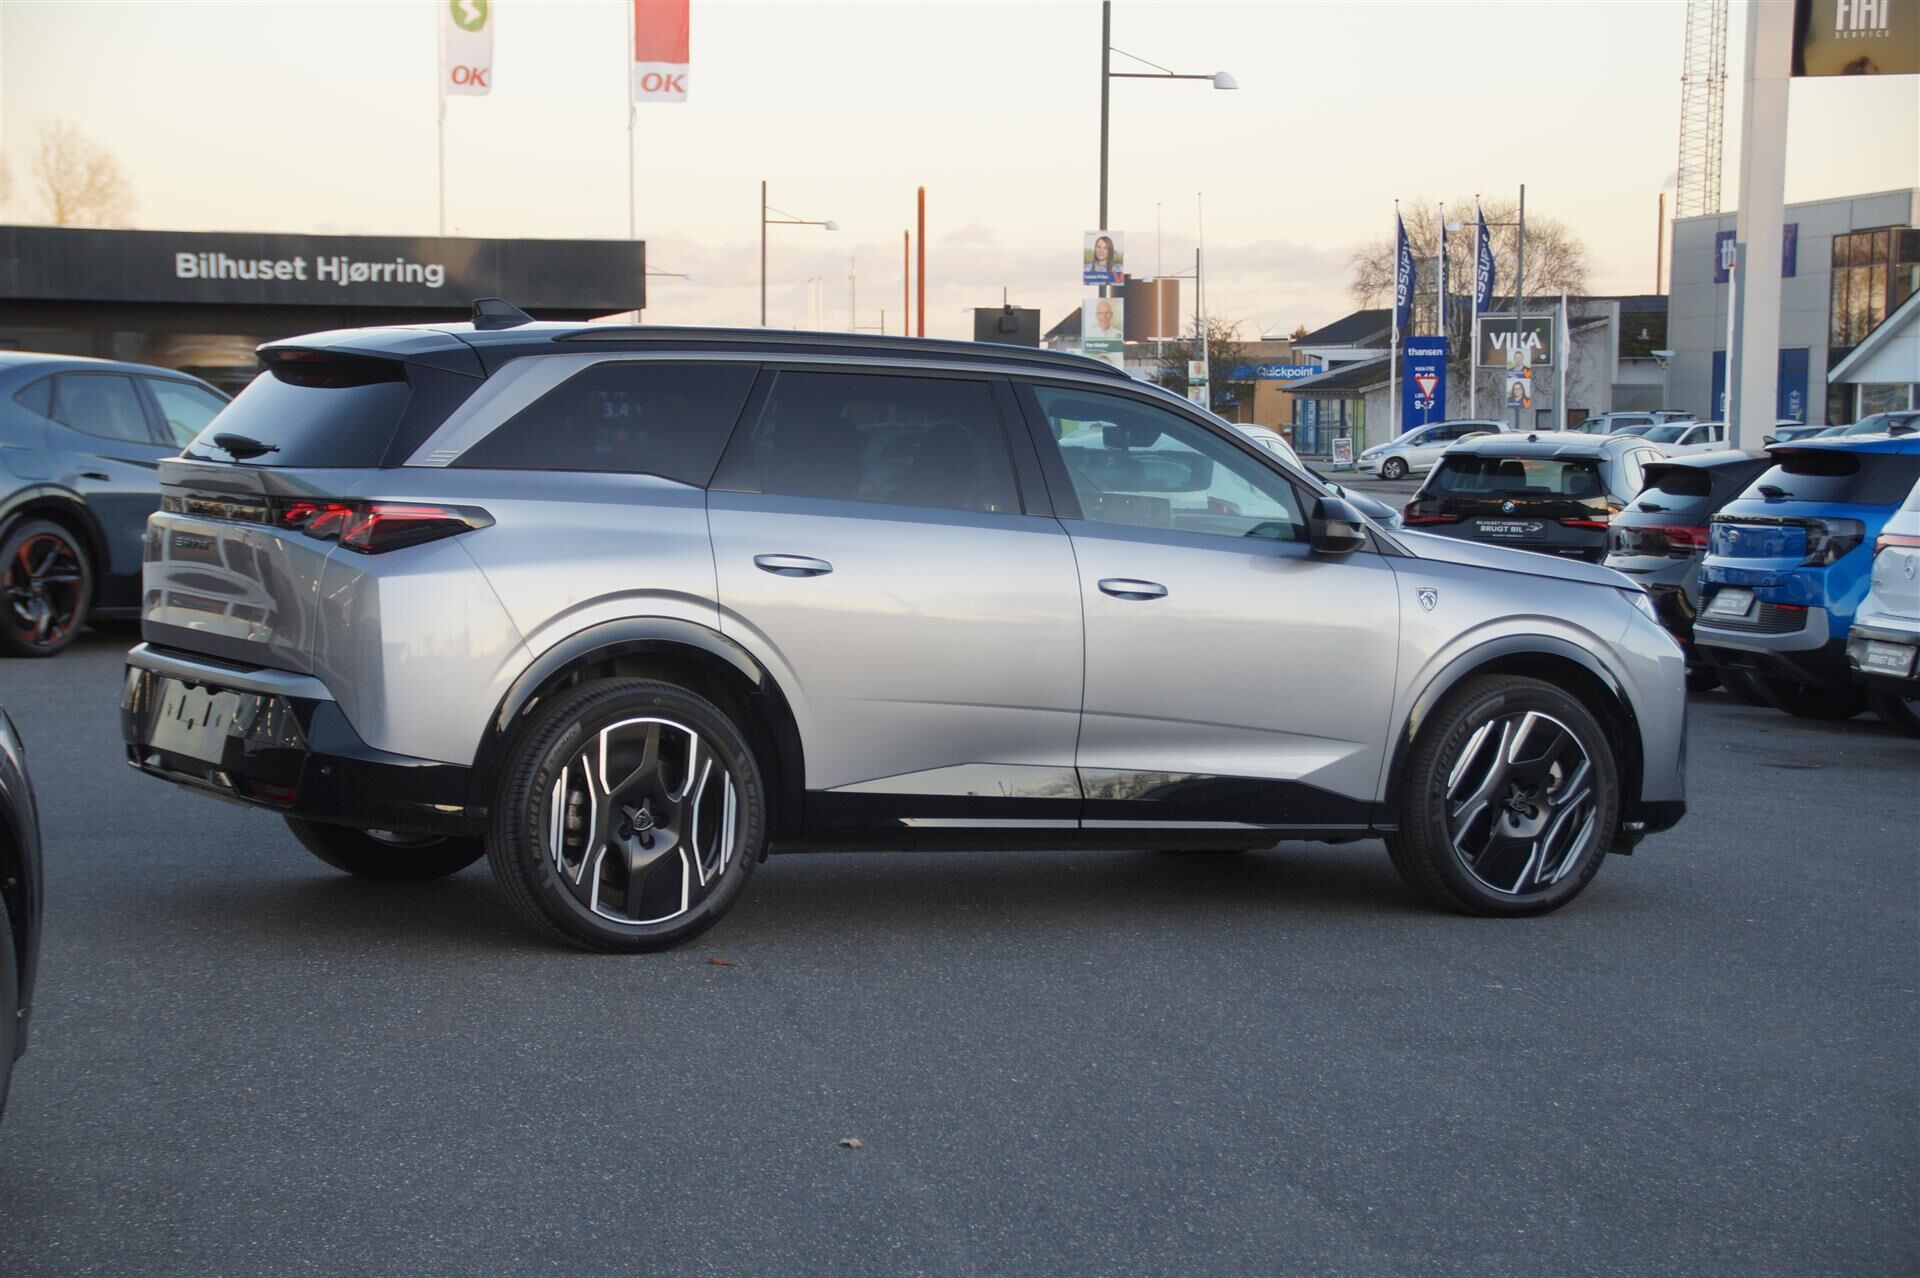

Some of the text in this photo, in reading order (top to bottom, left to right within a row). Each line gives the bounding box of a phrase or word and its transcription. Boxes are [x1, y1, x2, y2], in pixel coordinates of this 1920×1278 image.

[1835, 30, 1889, 39] SERVICE
[451, 65, 488, 87] OK
[641, 72, 687, 93] OK
[175, 252, 445, 288] Bilhuset Hjørring
[1489, 331, 1542, 350] VIKA
[1407, 347, 1443, 356] thansen
[1257, 366, 1313, 378] Quickpoint
[1480, 525, 1508, 533] BRUGT
[529, 772, 549, 860] MICHELIN
